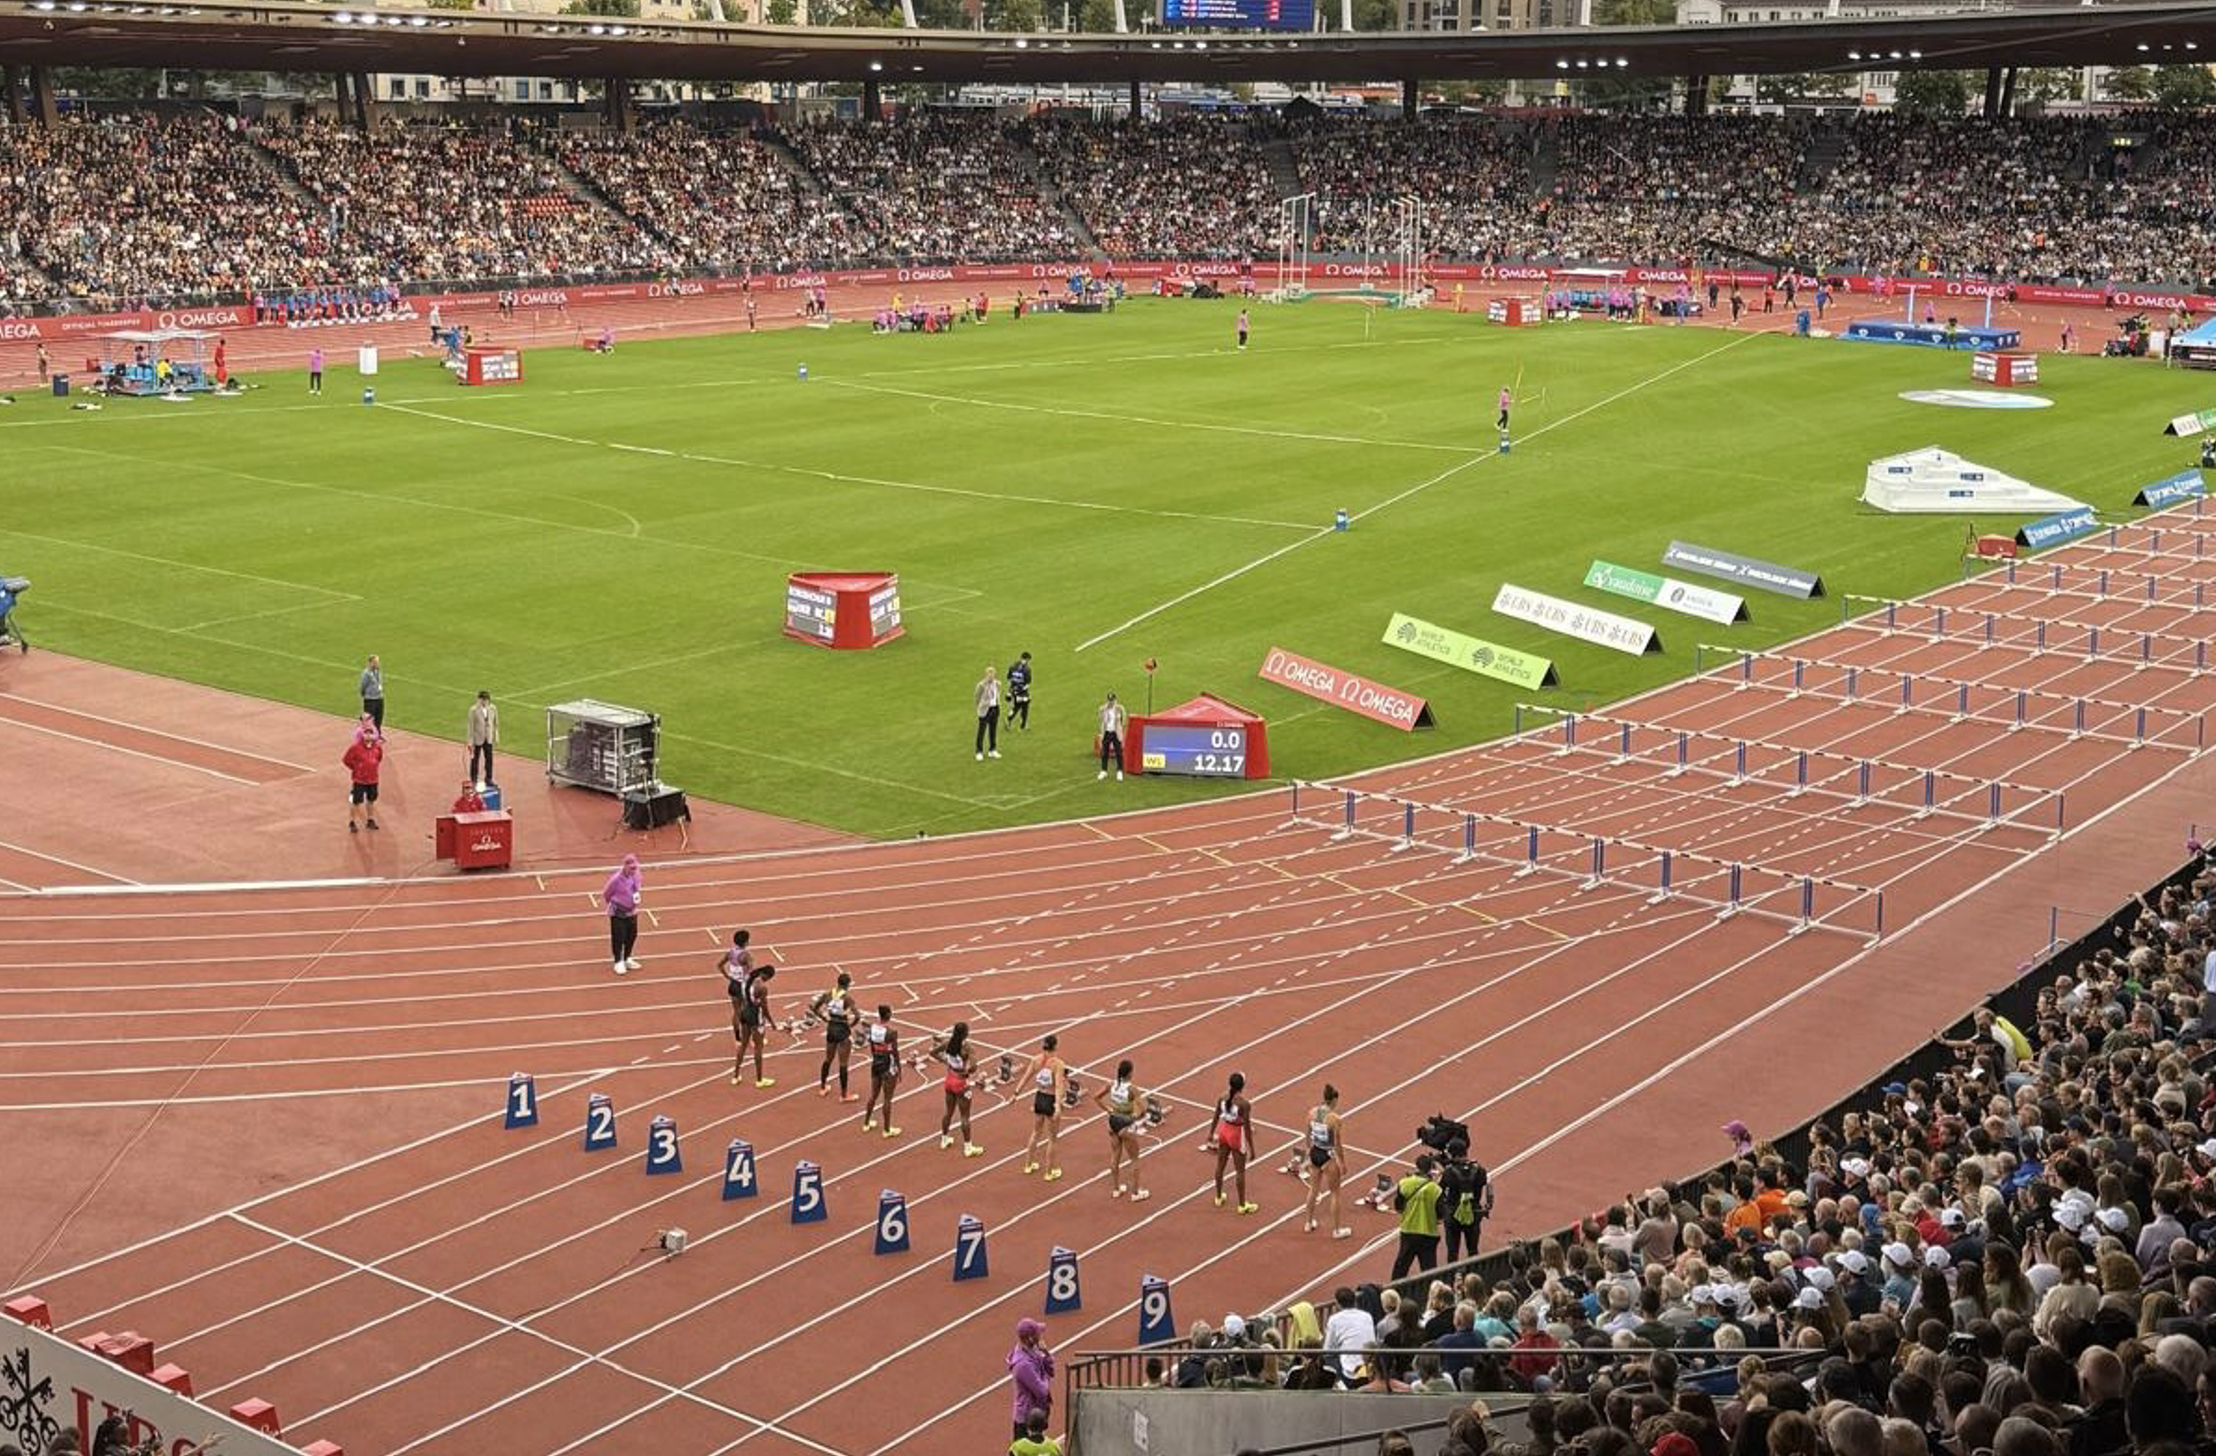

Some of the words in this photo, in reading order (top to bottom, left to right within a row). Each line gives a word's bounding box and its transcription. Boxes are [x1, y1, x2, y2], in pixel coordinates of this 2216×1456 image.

[789, 277, 827, 288] OMEGA
[912, 270, 954, 280] OMEGA
[1192, 265, 1239, 275] OMEGA
[1499, 267, 1548, 278] OMEGA
[1637, 271, 1688, 281] OMEGA
[521, 292, 568, 305] OMEGA
[2133, 296, 2187, 308] OMEGA
[180, 312, 240, 326] OMEGA
[1285, 662, 1335, 692] OMEGA
[1359, 690, 1414, 722] OMEGA
[1211, 731, 1240, 748] 0.0
[1194, 754, 1244, 772] 12.17
[512, 1084, 531, 1118] 1
[590, 1106, 613, 1141] 2
[653, 1129, 676, 1164] 3
[728, 1153, 752, 1188] 4
[799, 1175, 820, 1212] 5
[881, 1205, 905, 1242] 6
[960, 1231, 983, 1270] 7
[1051, 1264, 1077, 1300] 8
[1144, 1292, 1167, 1328] 9
